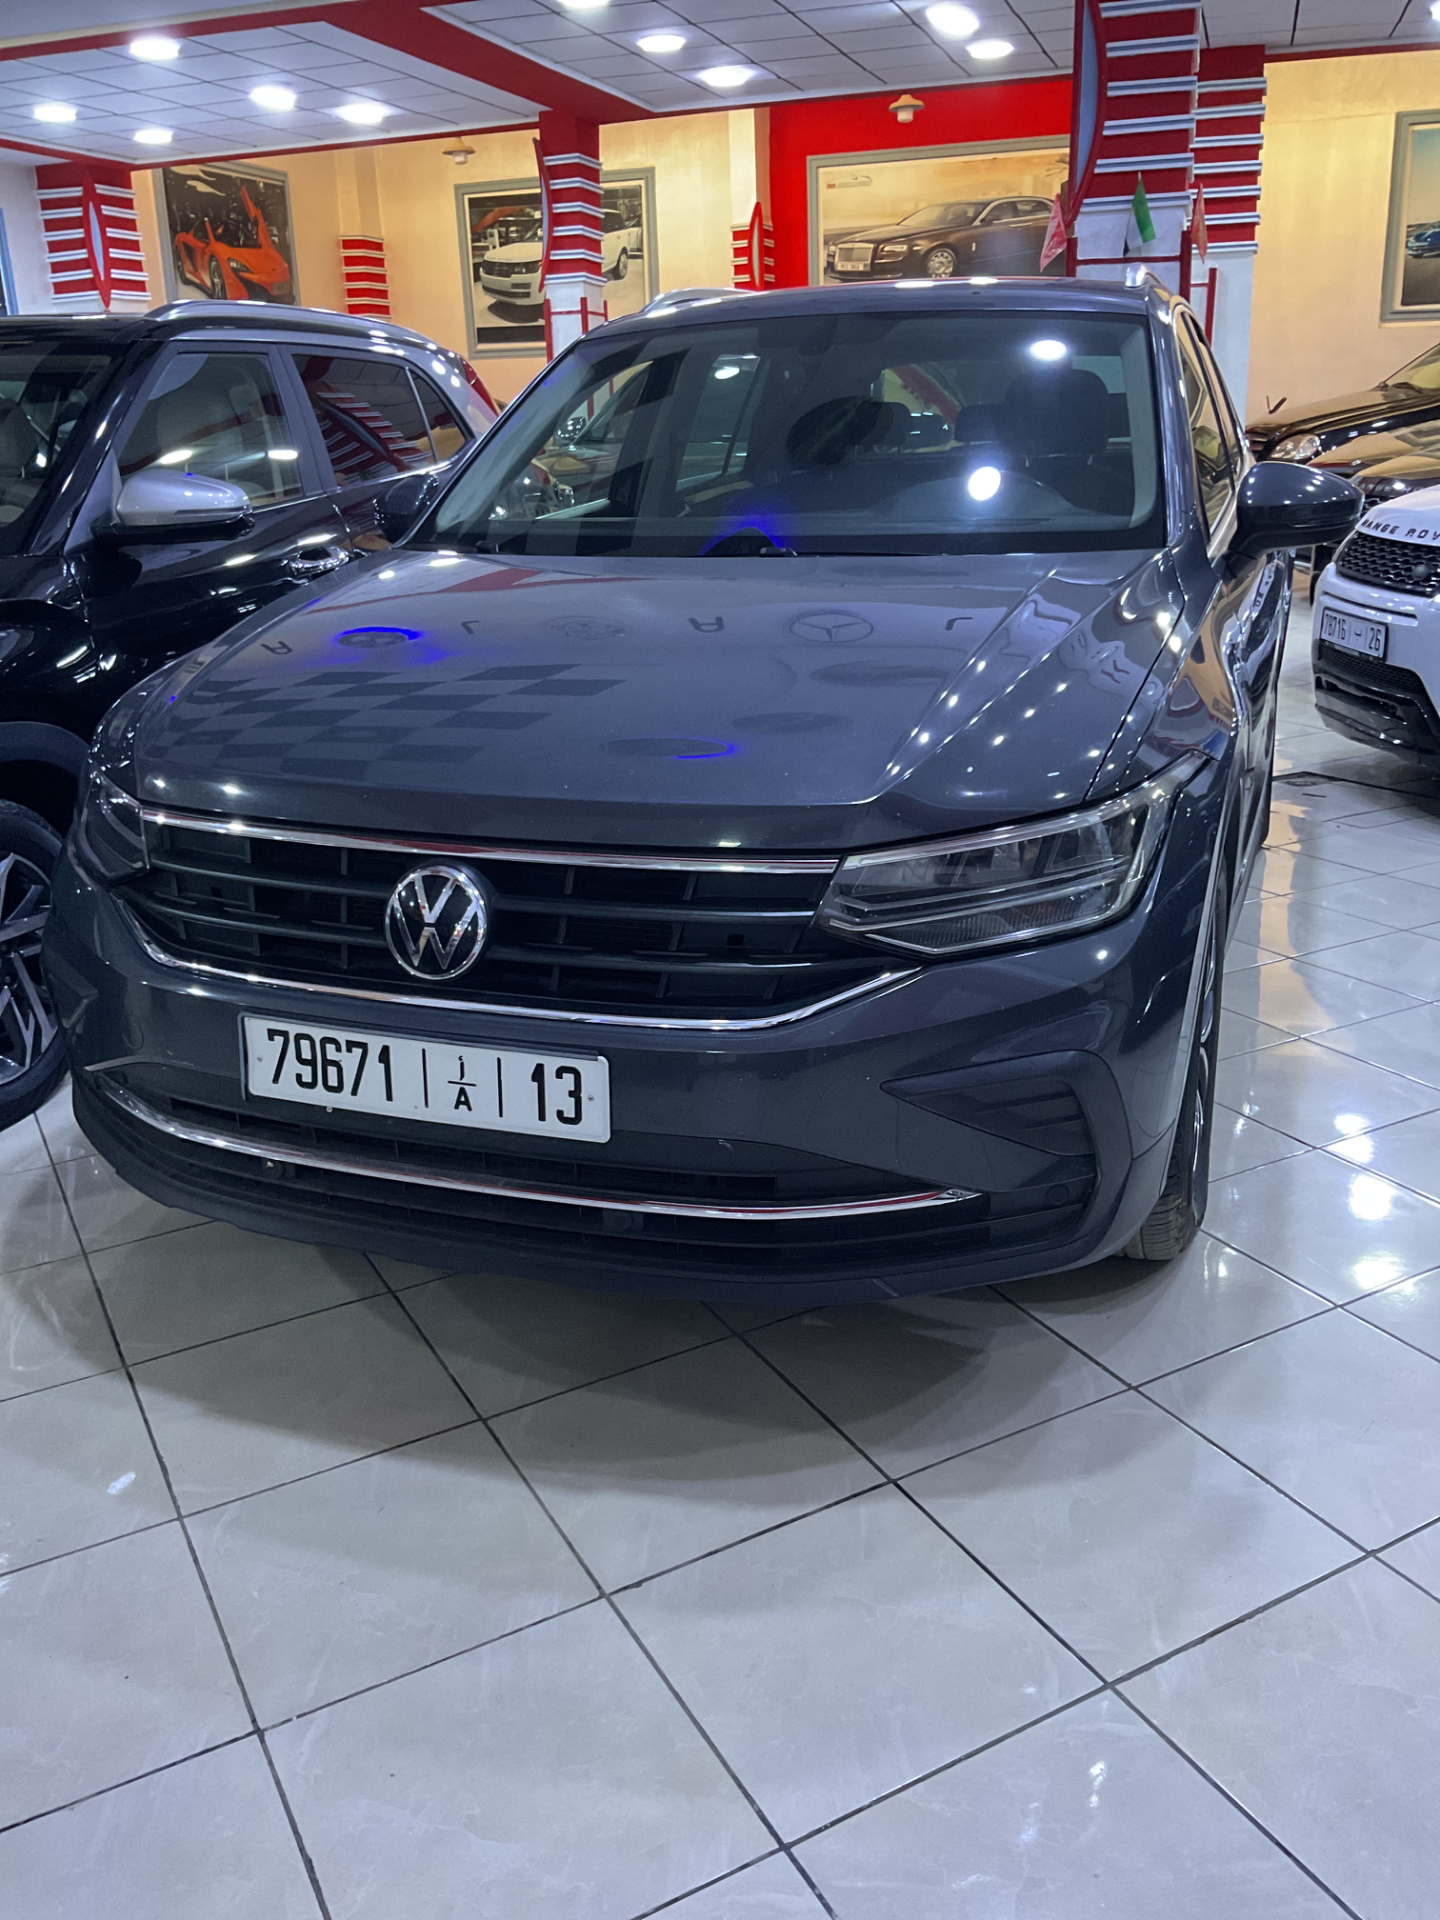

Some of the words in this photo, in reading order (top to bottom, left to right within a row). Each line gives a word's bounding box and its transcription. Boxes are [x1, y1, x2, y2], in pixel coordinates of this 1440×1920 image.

[1361, 519, 1400, 535] RANGE
[1368, 627, 1382, 651] 26
[391, 872, 479, 970] VW
[266, 1027, 394, 1102] 79671
[531, 1062, 583, 1125] 13
[454, 1086, 473, 1112] A
